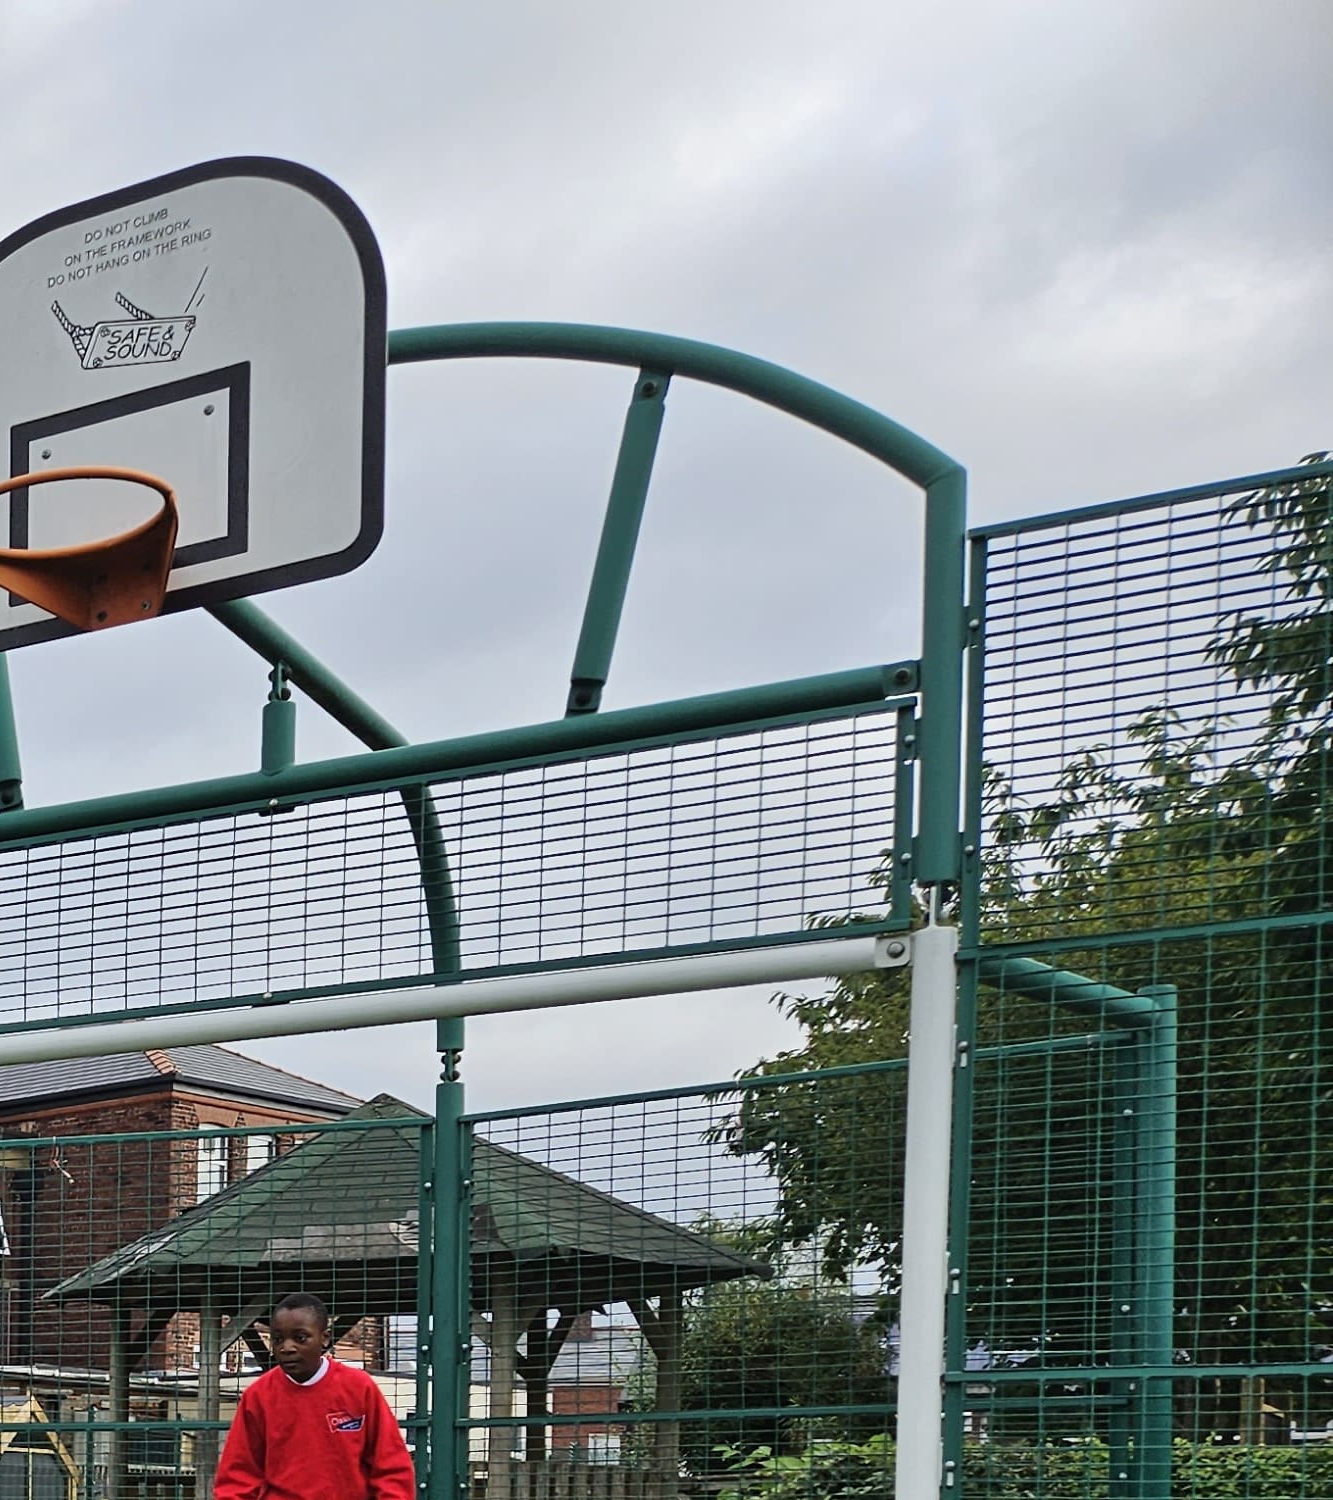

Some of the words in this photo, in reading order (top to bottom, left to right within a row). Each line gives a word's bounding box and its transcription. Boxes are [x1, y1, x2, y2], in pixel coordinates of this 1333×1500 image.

[64, 253, 82, 267] ON
[85, 244, 108, 262] THE
[110, 219, 192, 253] FRAMEWORK
[84, 229, 103, 244] DO
[106, 220, 130, 237] NOT
[133, 208, 169, 228] CLIMB
[47, 274, 66, 288] DO
[68, 265, 93, 282] NOT
[95, 255, 130, 273] HANG
[133, 249, 151, 262] ON
[154, 239, 178, 255] THE
[180, 228, 212, 247] RING
[104, 341, 172, 360] SOUND
[107, 326, 162, 344] SAFE
[162, 325, 174, 340] &
